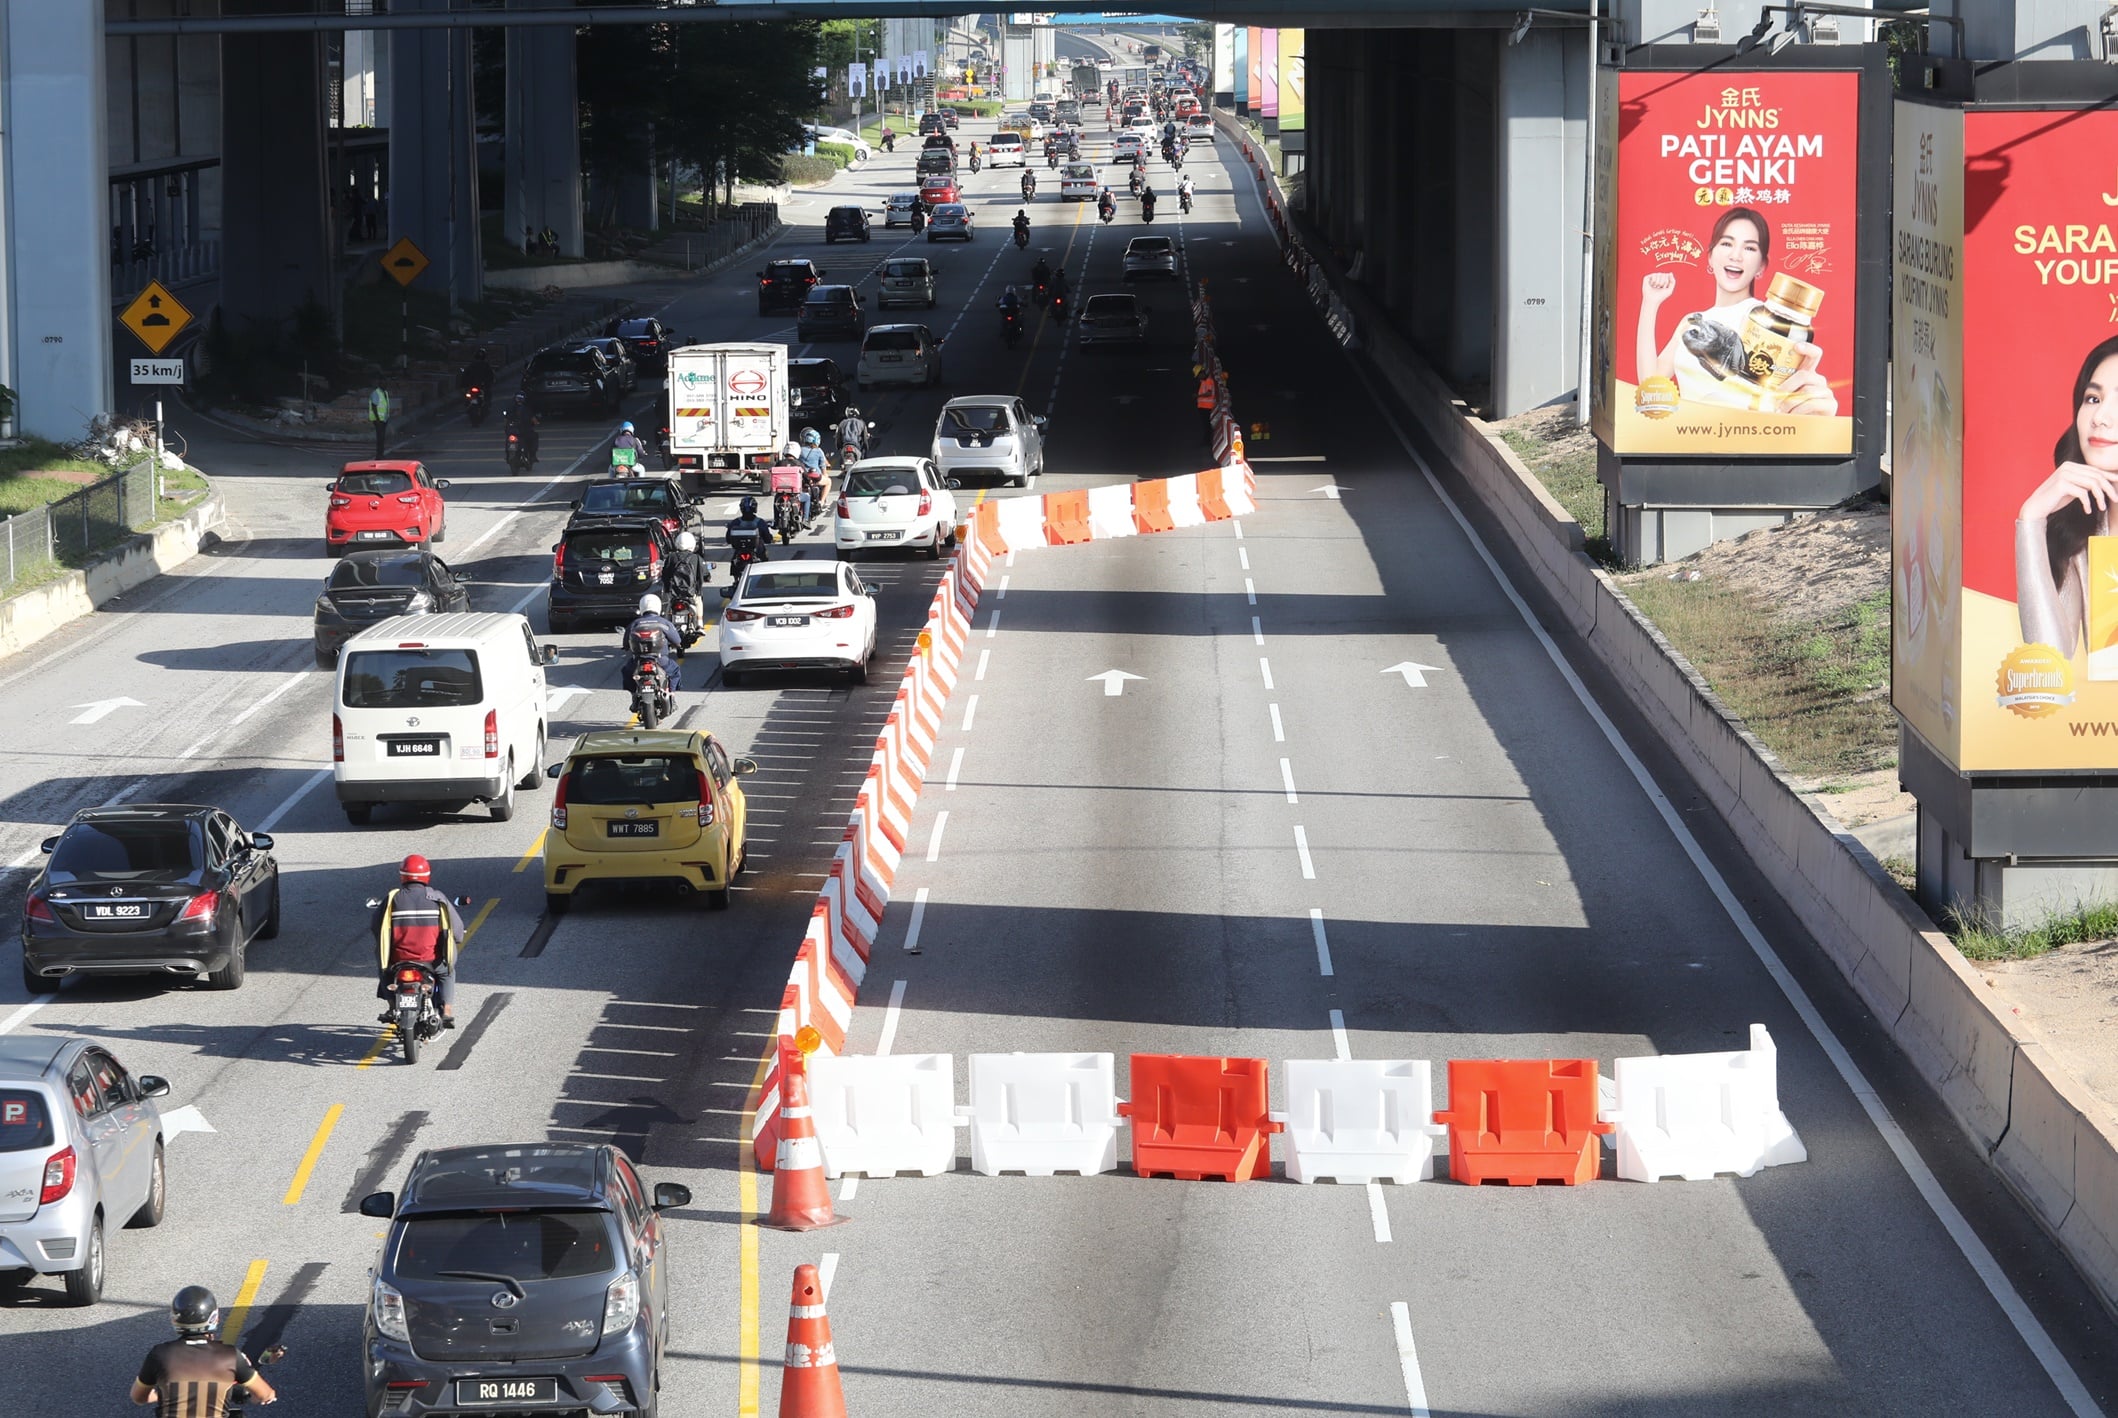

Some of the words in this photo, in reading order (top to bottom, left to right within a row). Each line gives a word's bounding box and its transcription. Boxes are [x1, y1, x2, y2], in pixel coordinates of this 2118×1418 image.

[1720, 87, 1762, 108] 金氏
[1697, 104, 1779, 128] JYNNS
[1661, 134, 1727, 158] PATI
[1735, 134, 1823, 158] AYAM
[1688, 158, 1796, 185] GENKI
[1911, 169, 1938, 228] JYNNS
[1898, 229, 1924, 271] SARANG
[1924, 238, 1954, 281] BURUNG
[1928, 281, 1950, 319] JYNNS
[133, 365, 149, 376] 35
[152, 364, 182, 379] km/j
[1676, 422, 1797, 438] www.jynns.com
[2007, 669, 2063, 692] Superbrands
[396, 744, 411, 753] VJH
[612, 824, 630, 834] WWT
[633, 823, 654, 833] 7885
[95, 906, 113, 916] VDL
[116, 905, 141, 916] 9223
[5, 1103, 24, 1121] P
[561, 1318, 595, 1331] AXIA
[479, 1382, 499, 1399] RQ
[502, 1382, 536, 1399] 1446
